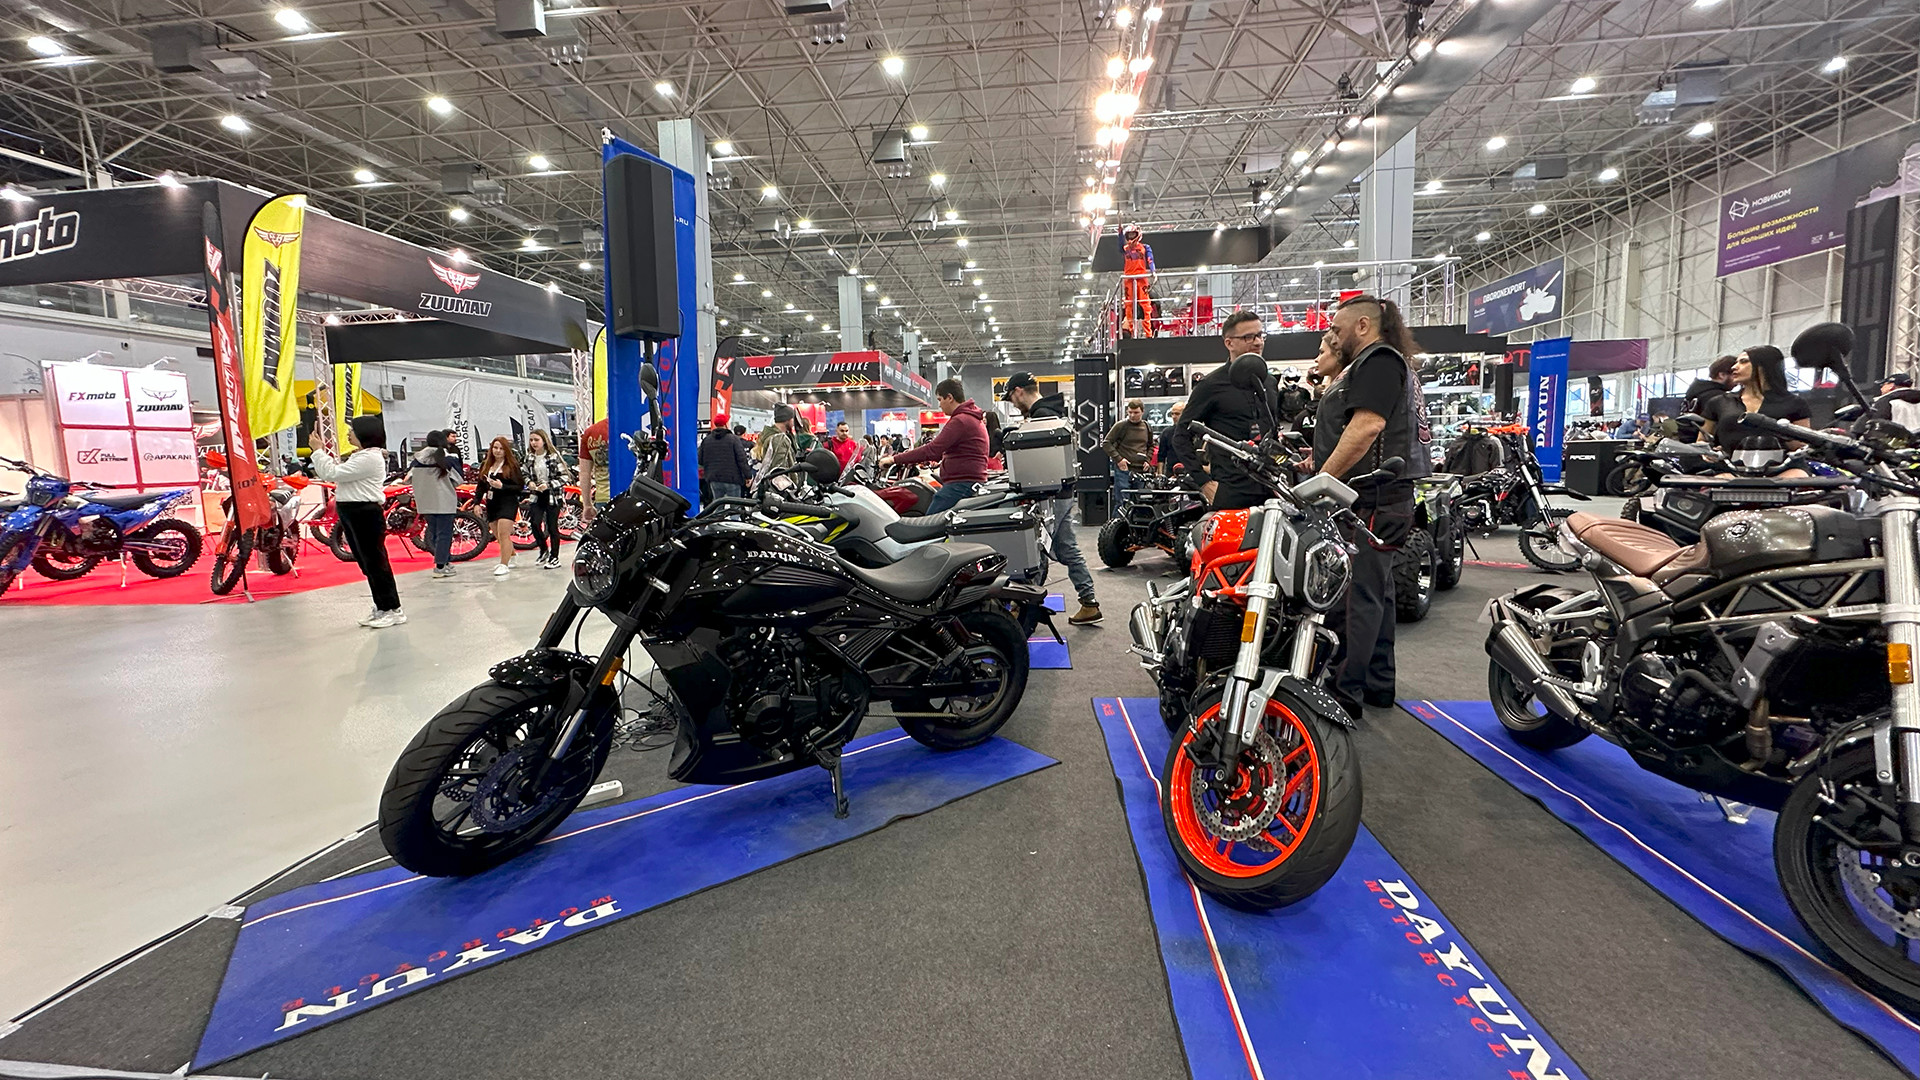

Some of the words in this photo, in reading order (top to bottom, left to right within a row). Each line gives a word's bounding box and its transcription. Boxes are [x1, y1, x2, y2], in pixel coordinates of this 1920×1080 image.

[1751, 187, 1792, 208] НОВИКОМ
[1725, 238, 1740, 251] для
[1741, 228, 1775, 245] больших
[1776, 222, 1797, 237] идей
[1727, 223, 1760, 241] Большие
[1761, 206, 1819, 230] возможности
[418, 293, 492, 317] ZUUMAV
[263, 257, 281, 392] ZUUMAV
[740, 364, 800, 376] VELOCITY
[810, 361, 870, 374] ALPINEBIKE
[136, 404, 184, 413] ZUUMAV
[1535, 375, 1550, 448] DAYUN
[461, 420, 470, 460] MOTORS
[747, 550, 798, 563] DAYUN
[274, 899, 622, 1032] DAYUN
[281, 894, 613, 1012] MOTORCYCLE
[1378, 878, 1567, 1080] DAYUN
